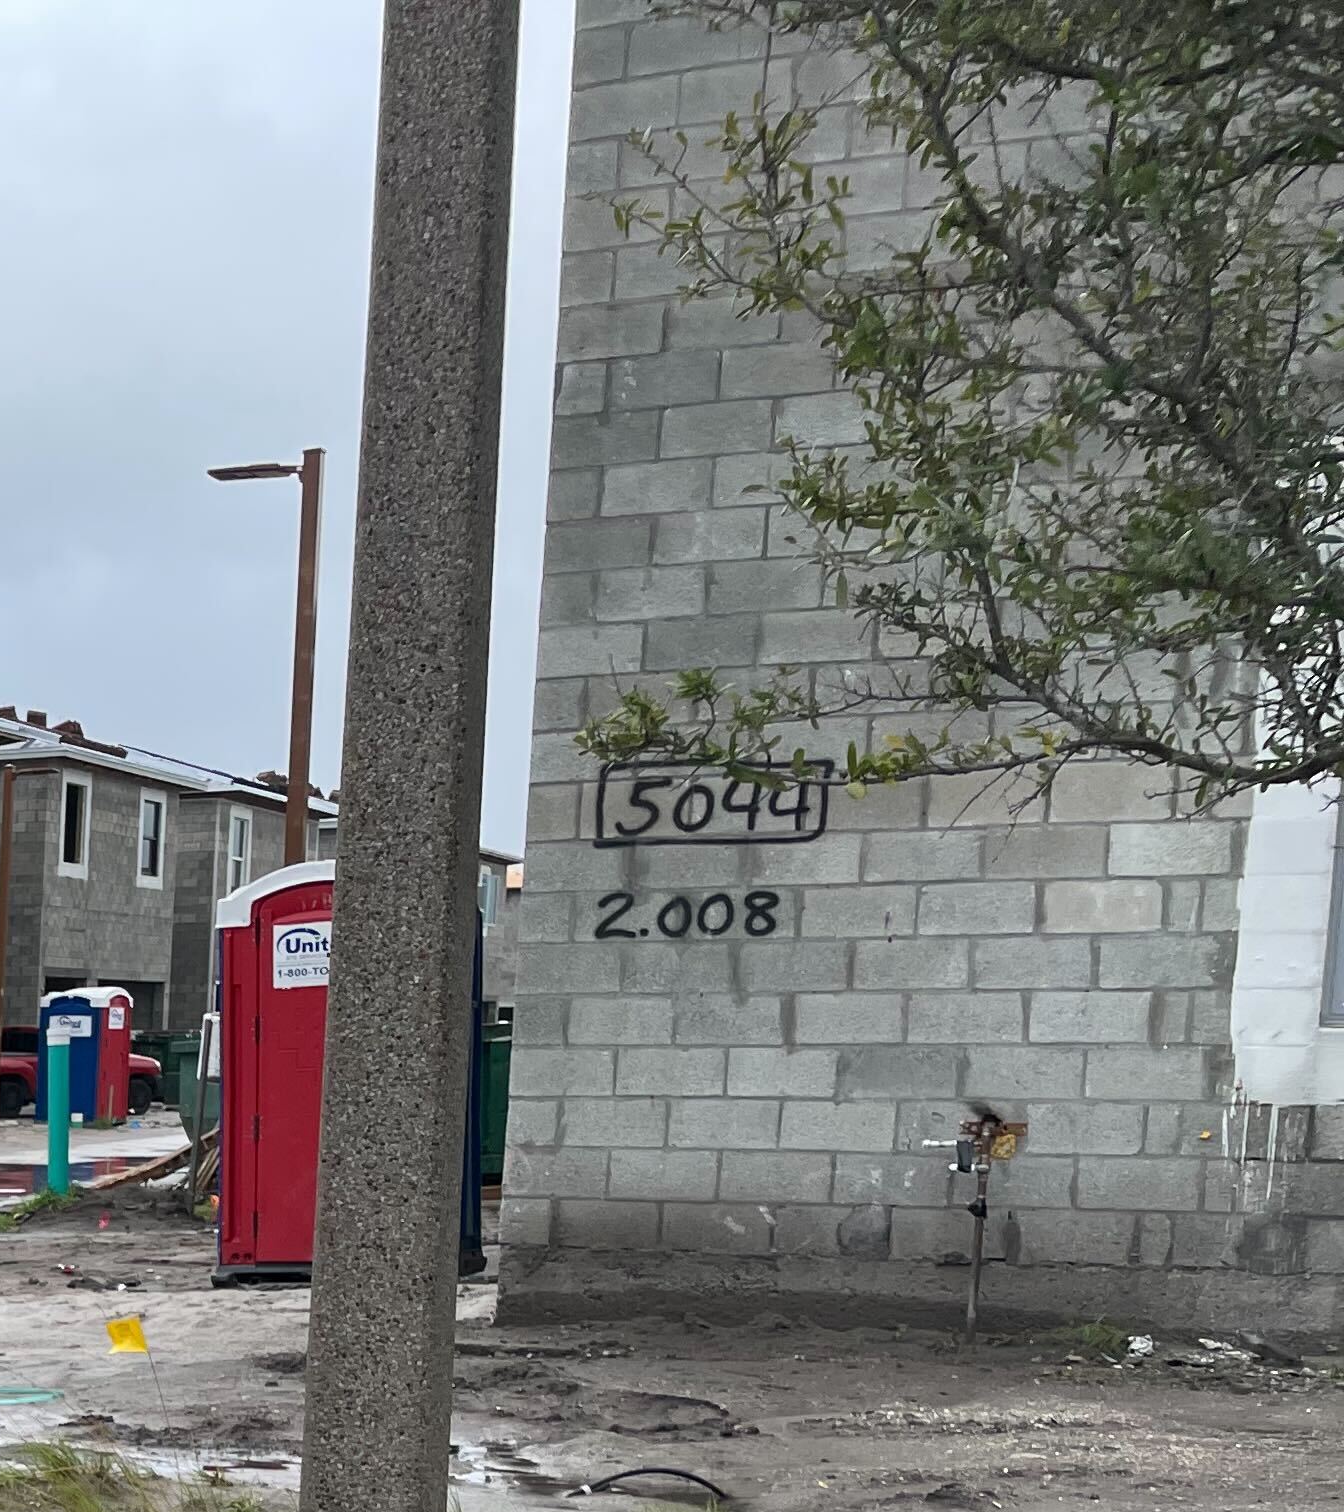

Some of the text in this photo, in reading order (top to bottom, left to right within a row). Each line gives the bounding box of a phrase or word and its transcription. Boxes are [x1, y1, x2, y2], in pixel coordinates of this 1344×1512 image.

[615, 779, 810, 835] 5044
[594, 891, 780, 939] 2.008
[285, 937, 329, 953] Unit
[278, 967, 329, 978] 1-800-TO
